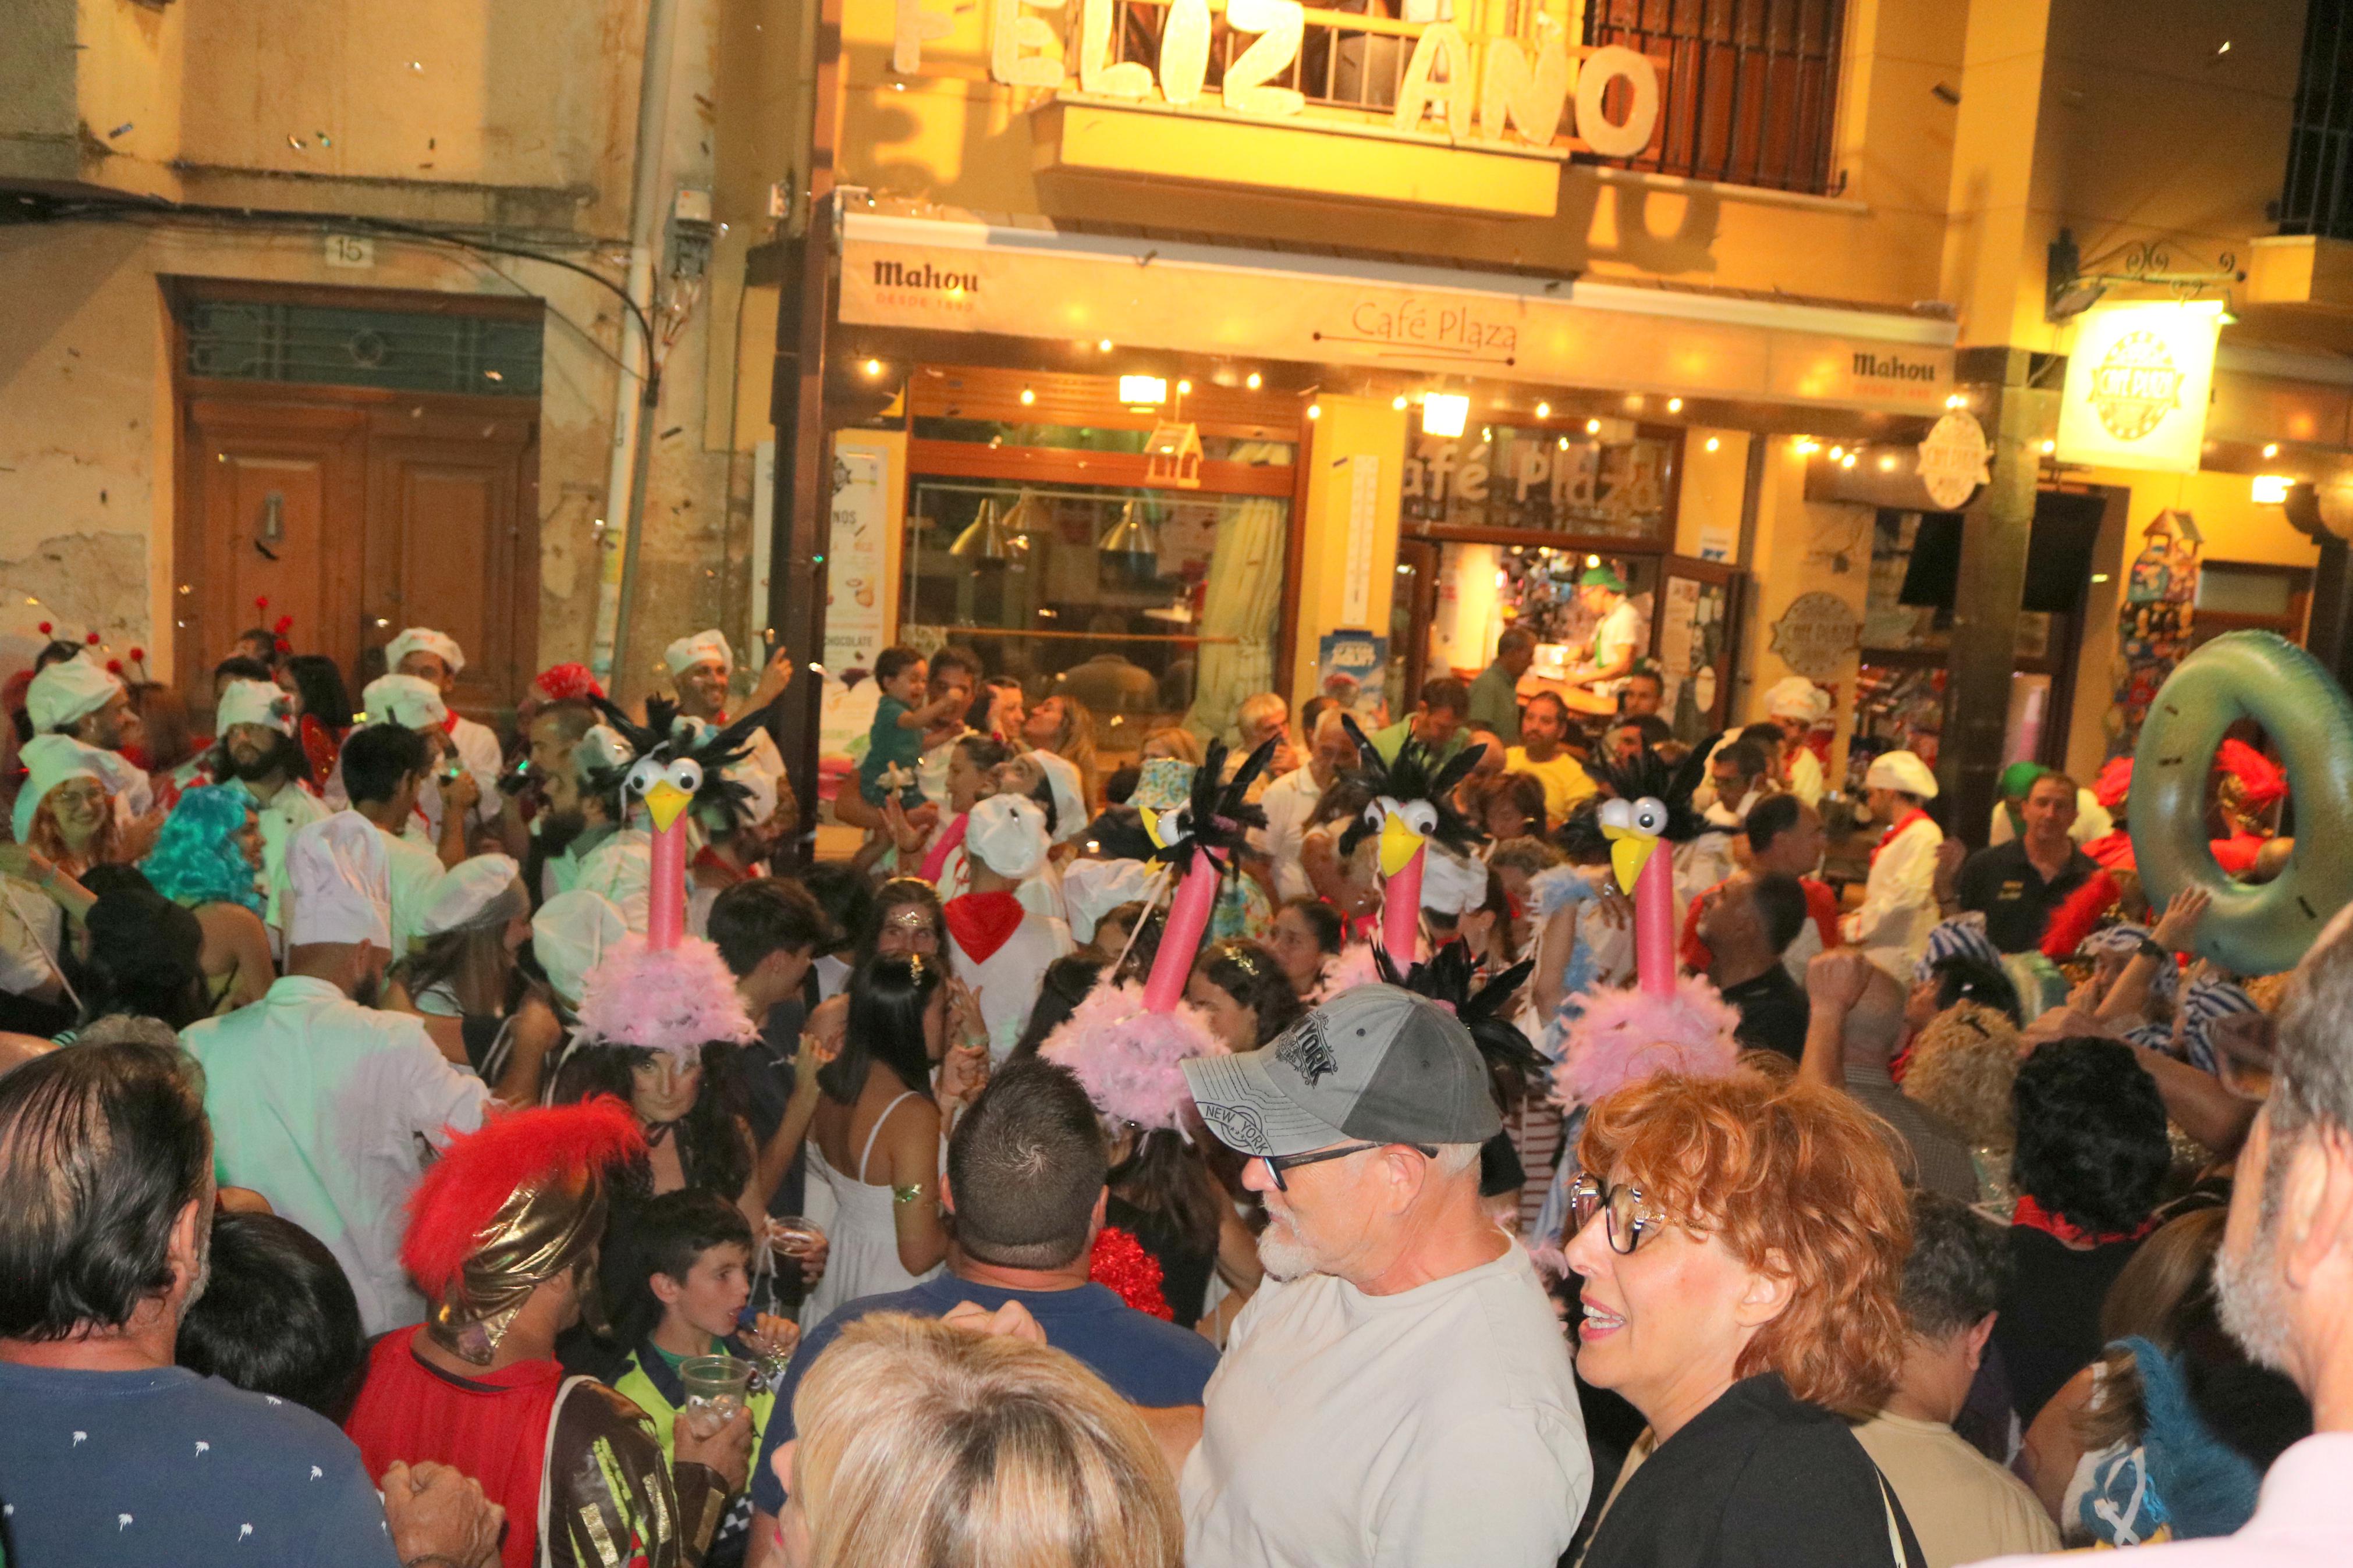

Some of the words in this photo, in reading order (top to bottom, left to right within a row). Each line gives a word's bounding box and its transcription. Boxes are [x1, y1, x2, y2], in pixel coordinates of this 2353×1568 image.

[893, 0, 1305, 115] FELIZ
[338, 237, 363, 262] 15
[874, 259, 978, 292] Mahou
[1352, 298, 1426, 340] Café
[1438, 307, 1517, 351] Plaza
[1853, 353, 1935, 382] Mahou
[1401, 442, 1489, 502] afé
[1516, 447, 1660, 512] Plaza
[1298, 1022, 1333, 1086] YORK
[1205, 1105, 1236, 1123] NEW
[1241, 1121, 1269, 1155] YORK
